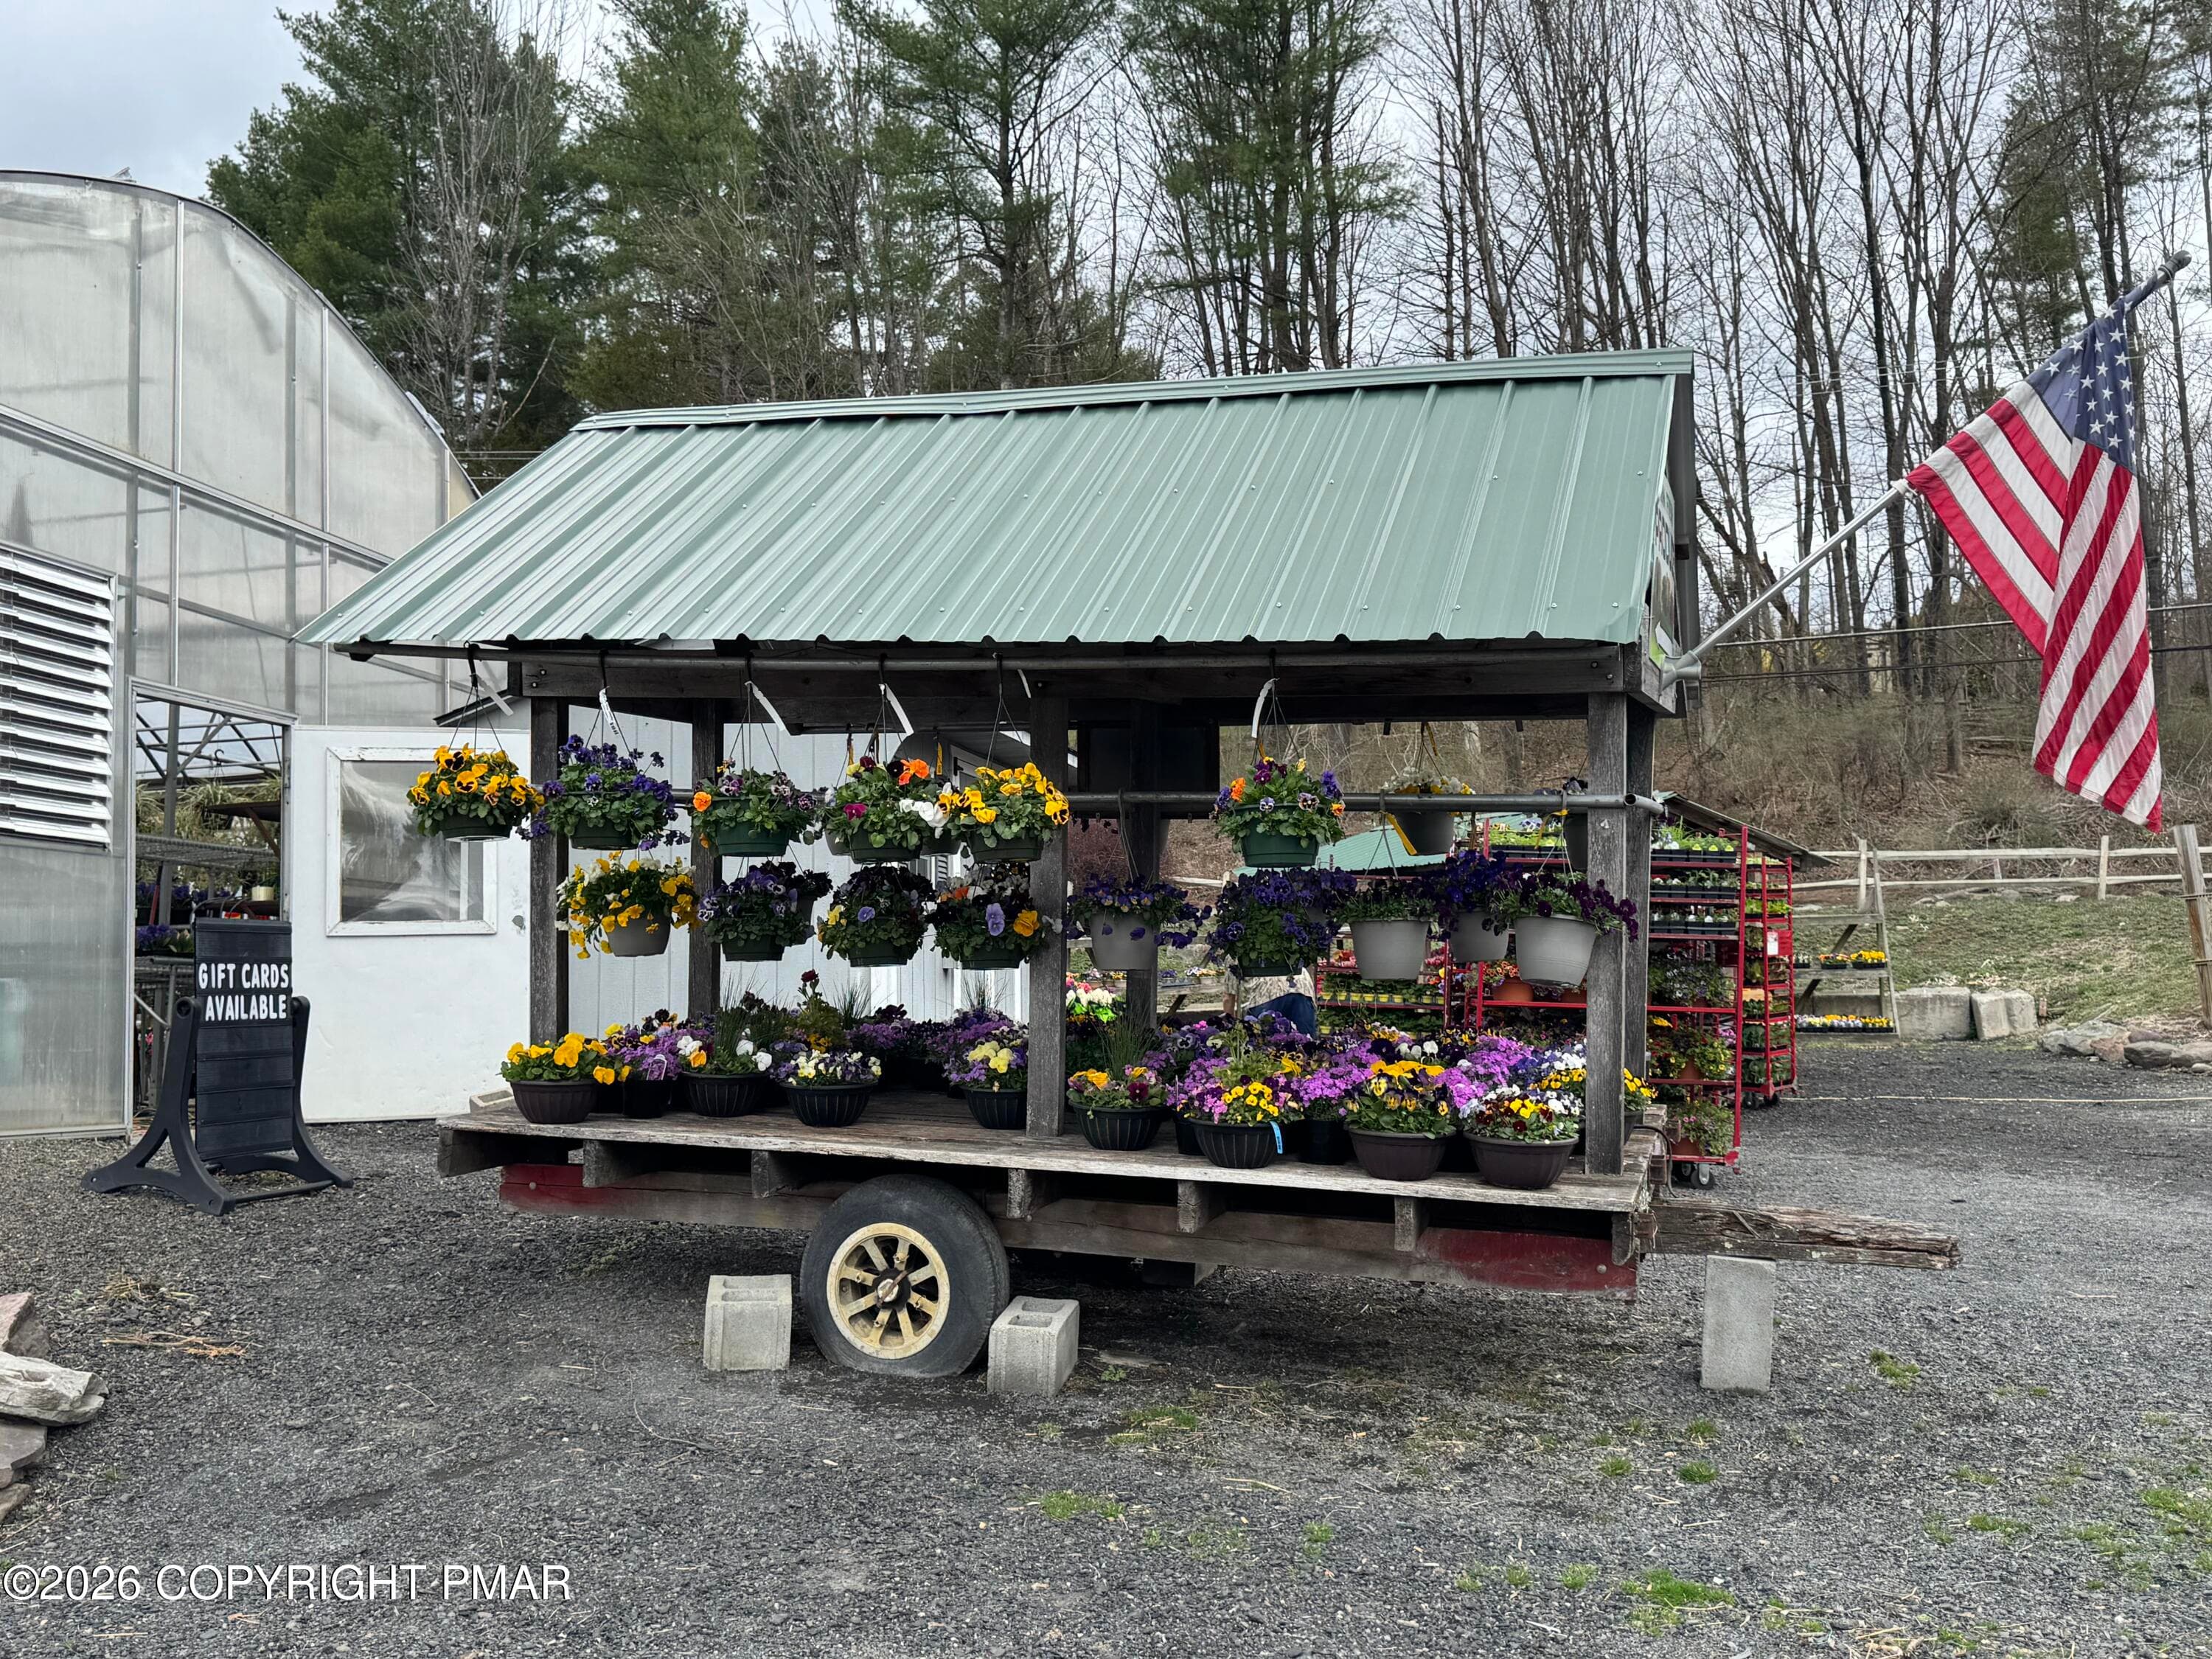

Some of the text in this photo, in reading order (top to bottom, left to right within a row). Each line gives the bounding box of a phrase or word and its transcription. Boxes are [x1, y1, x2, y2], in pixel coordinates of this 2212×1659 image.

[198, 962, 289, 990] GIFT CARDS
[205, 994, 287, 1022] AVAILABLE
